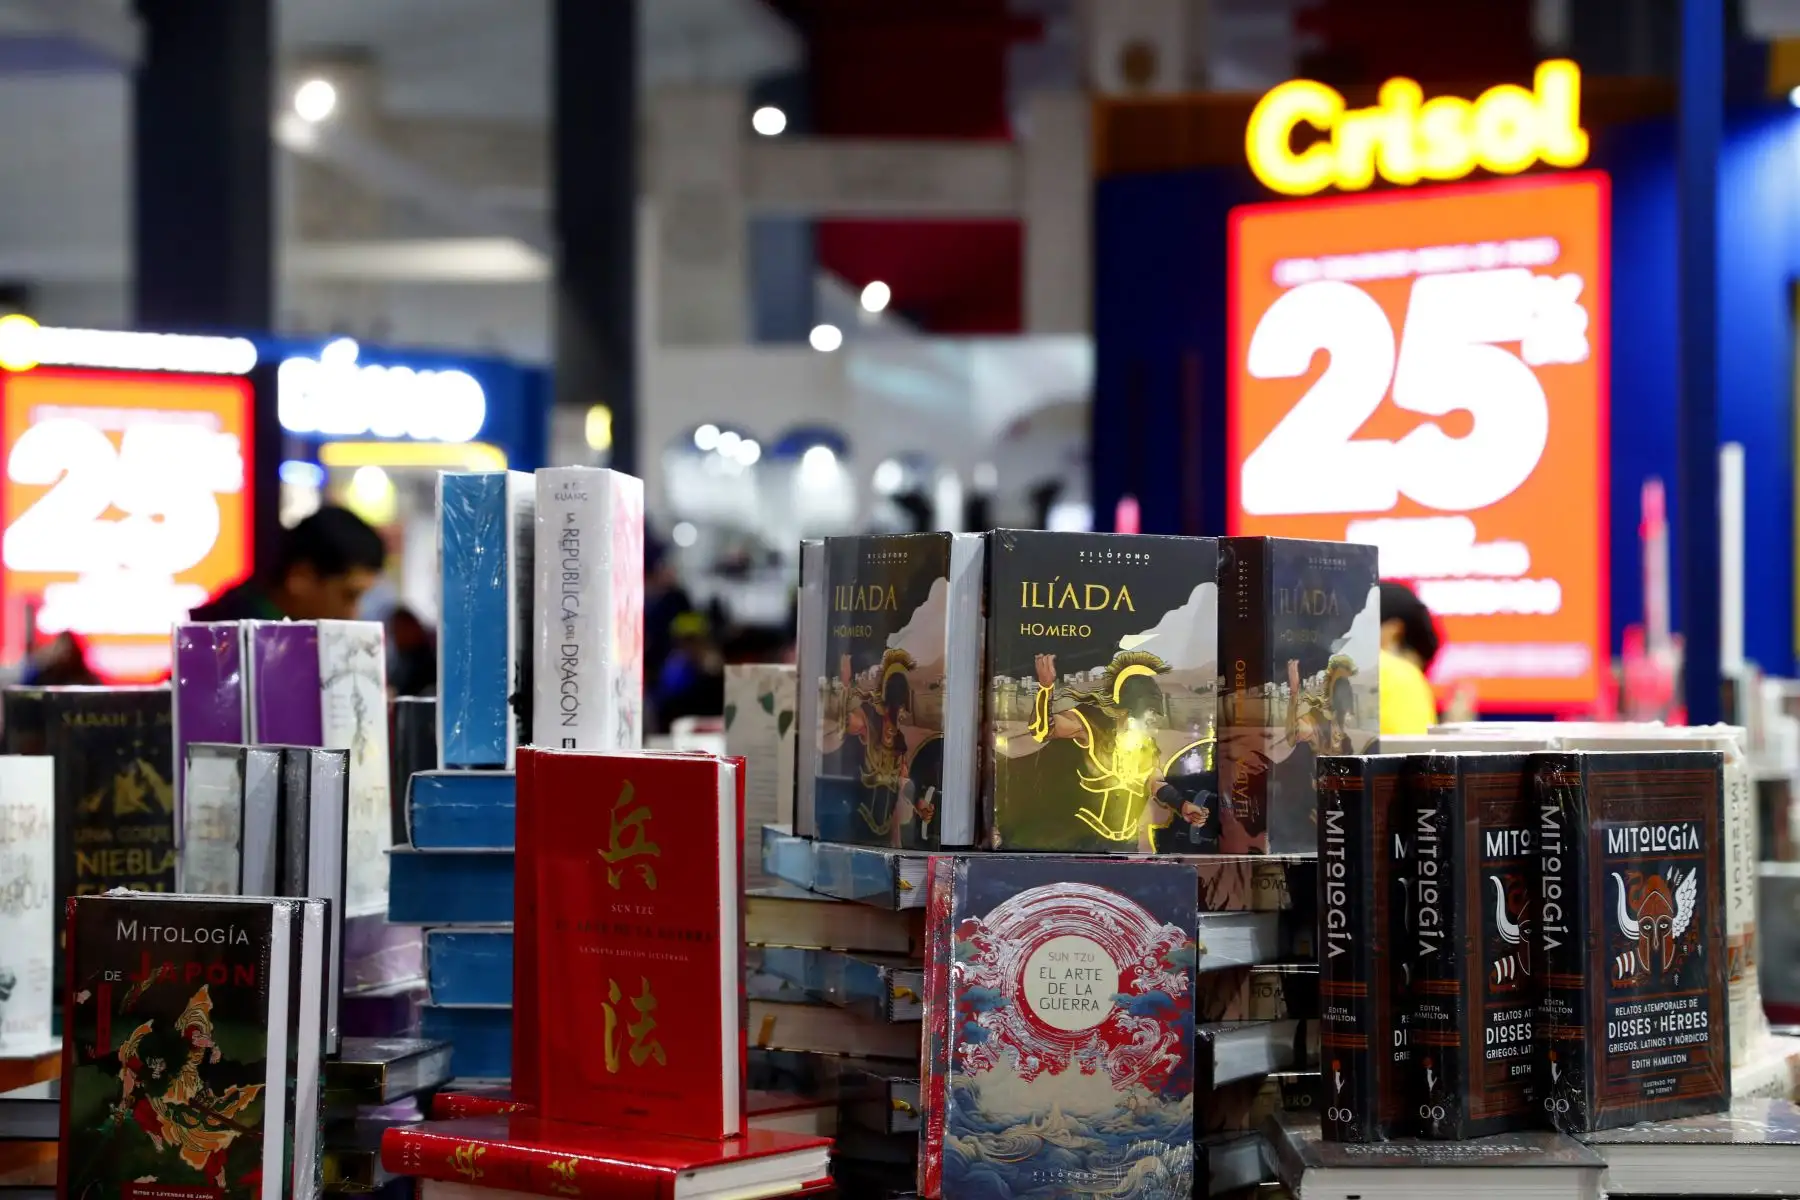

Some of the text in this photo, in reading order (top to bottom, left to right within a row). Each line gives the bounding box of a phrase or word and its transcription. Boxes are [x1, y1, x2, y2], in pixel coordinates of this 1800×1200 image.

[1245, 60, 1589, 194] Crisol
[1080, 549, 1150, 560] XILÓFONO
[561, 528, 580, 622] REPÚBLICA
[834, 576, 898, 611] ILÍADA
[1021, 576, 1136, 612] ILÍADA
[1280, 579, 1340, 616] ILÍADA
[833, 625, 873, 638] HOMERO
[1021, 623, 1092, 638] HOMERO
[560, 644, 580, 727] DRAGÓN
[1486, 829, 1532, 857] MITO
[1608, 823, 1699, 854] MITOLOGÍA
[1326, 810, 1353, 959] MITOLOGÍA
[1417, 808, 1445, 957] MITOLOGÍA
[1540, 805, 1569, 951] MITOLOGÍA
[116, 919, 249, 945] MITOLOGÍA
[1048, 952, 1095, 963] SUN TZU
[104, 950, 256, 987] DE JAPÓN
[1040, 967, 1104, 981] EL ARTE
[1048, 982, 1092, 995] DE LA
[1040, 997, 1100, 1011] GUERRA
[1328, 1006, 1348, 1014] EDITH
[1538, 1005, 1573, 1014] HAMILTON
[1615, 998, 1698, 1016] RELATOS ATEMPORALES DE
[1322, 1014, 1356, 1022] HAMILTON
[1414, 1011, 1450, 1020] HAMILTON
[1494, 1008, 1534, 1022] RELATOS AT
[1486, 1022, 1532, 1045] DIOSES
[1608, 1018, 1651, 1039] DIOSES
[1660, 1011, 1708, 1033] HÉROES
[1394, 1029, 1408, 1046] DI
[1640, 1038, 1667, 1049] LATINOS
[1668, 1036, 1674, 1045] Y
[1675, 1032, 1709, 1045] NÓRDICOS
[1394, 1050, 1411, 1061] GRIE
[1631, 1054, 1688, 1070] EDITH HAMILTON
[1511, 1064, 1532, 1076] EDITH
